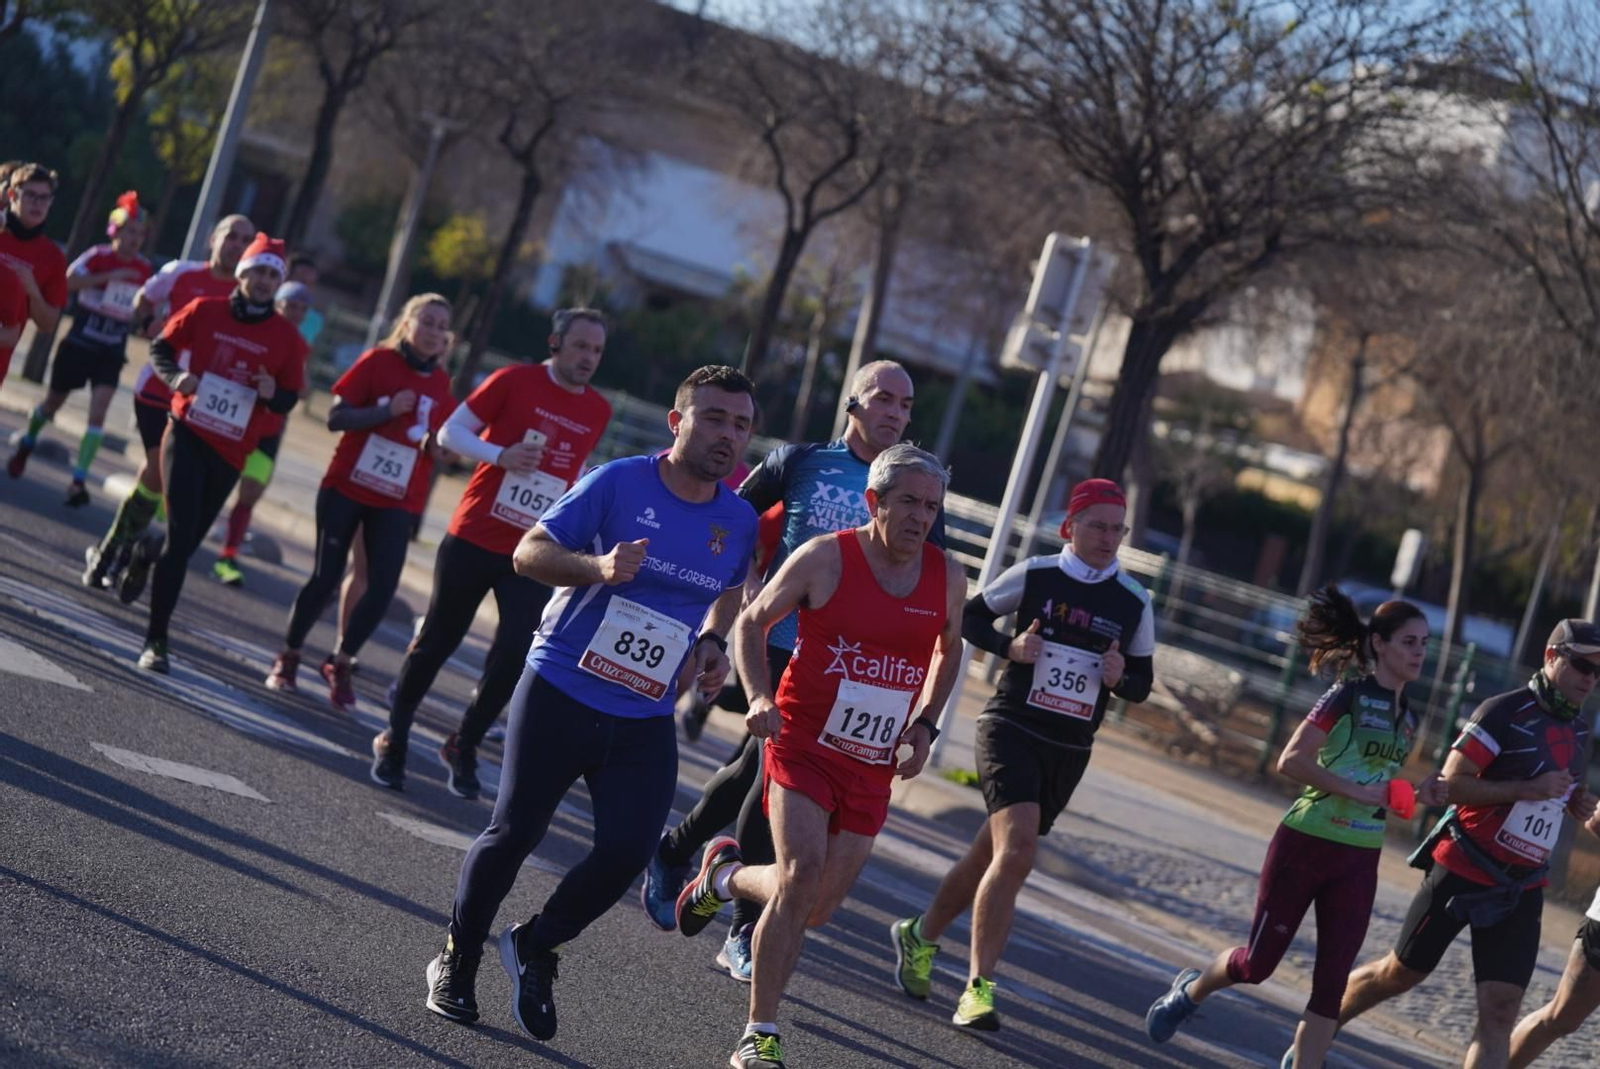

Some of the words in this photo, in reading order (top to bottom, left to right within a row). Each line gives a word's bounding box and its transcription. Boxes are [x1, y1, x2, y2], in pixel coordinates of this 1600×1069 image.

[206, 394, 238, 418] 301
[372, 455, 403, 478] 753
[511, 485, 554, 514] 1057
[640, 556, 677, 576] ETISME
[678, 568, 722, 592] CORBERA
[614, 631, 665, 669] 839
[590, 655, 651, 691] Cruzcampo
[852, 655, 924, 685] califas
[1048, 667, 1088, 694] 356
[840, 707, 896, 743] 1218
[1523, 814, 1553, 840] 101
